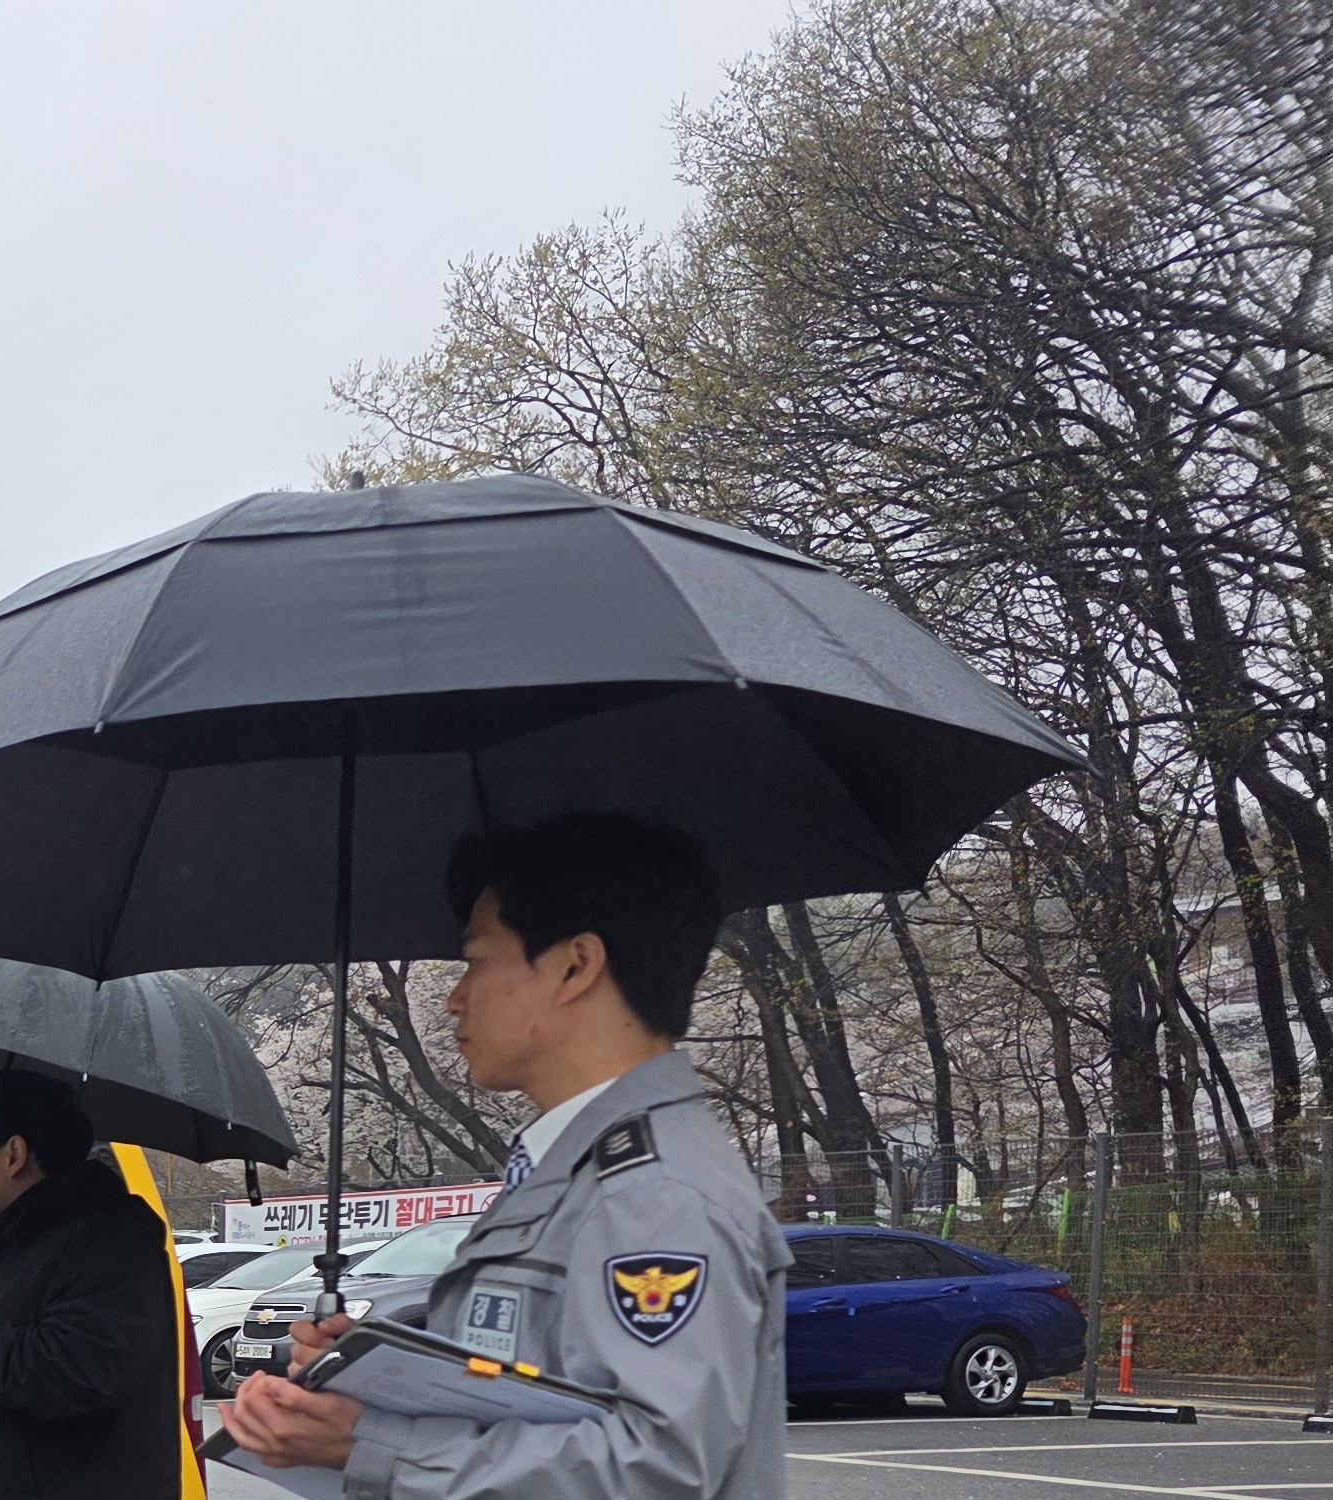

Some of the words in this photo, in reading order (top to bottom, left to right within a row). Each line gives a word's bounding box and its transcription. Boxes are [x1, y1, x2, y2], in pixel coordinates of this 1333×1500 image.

[264, 1204, 312, 1231] 쓰레기
[396, 1194, 473, 1227] 절대금지
[468, 1333, 511, 1352] POLICE
